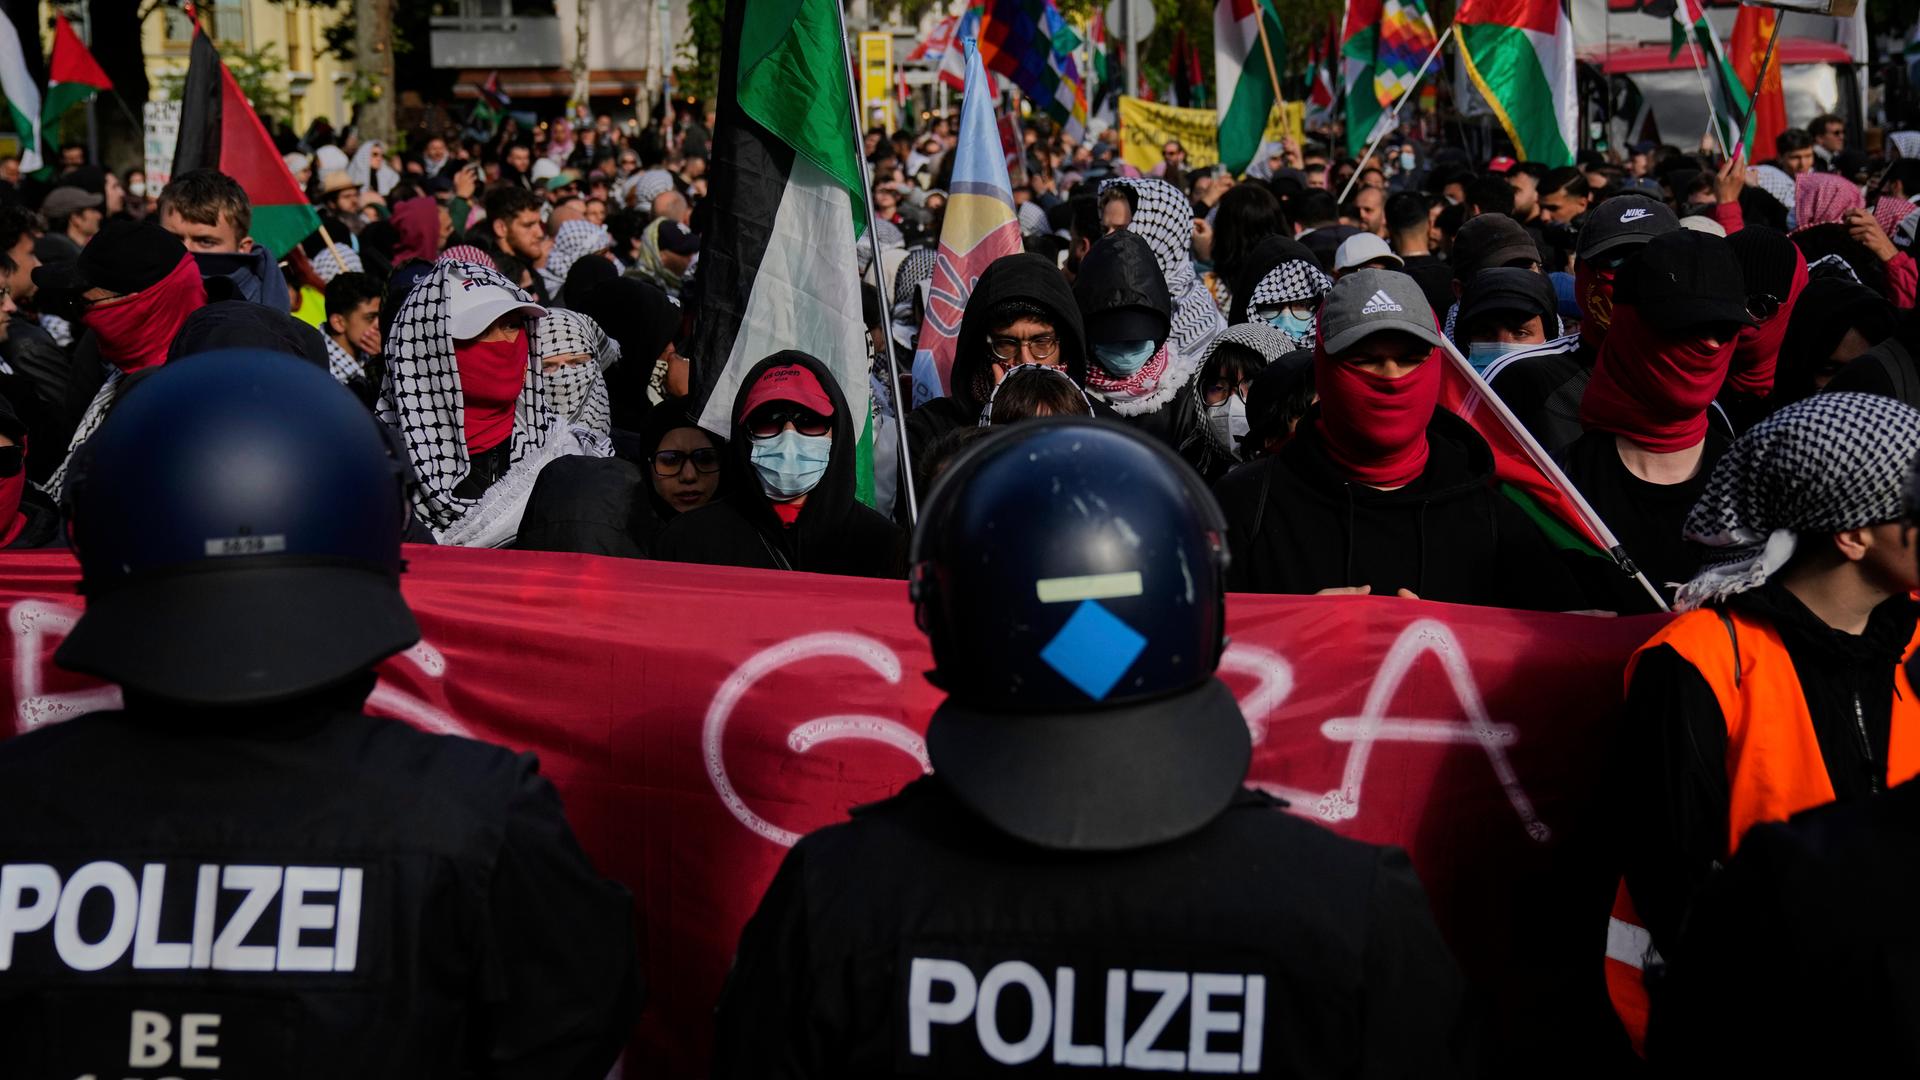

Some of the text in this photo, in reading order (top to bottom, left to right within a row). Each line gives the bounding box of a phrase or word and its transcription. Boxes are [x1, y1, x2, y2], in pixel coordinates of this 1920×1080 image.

[1625, 208, 1647, 217] NIKE
[1362, 303, 1403, 315] adidas
[774, 370, 801, 378] open
[0, 860, 364, 972] POLIZEI
[908, 957, 1266, 1073] POLIZEI
[129, 1010, 222, 1069] BE
